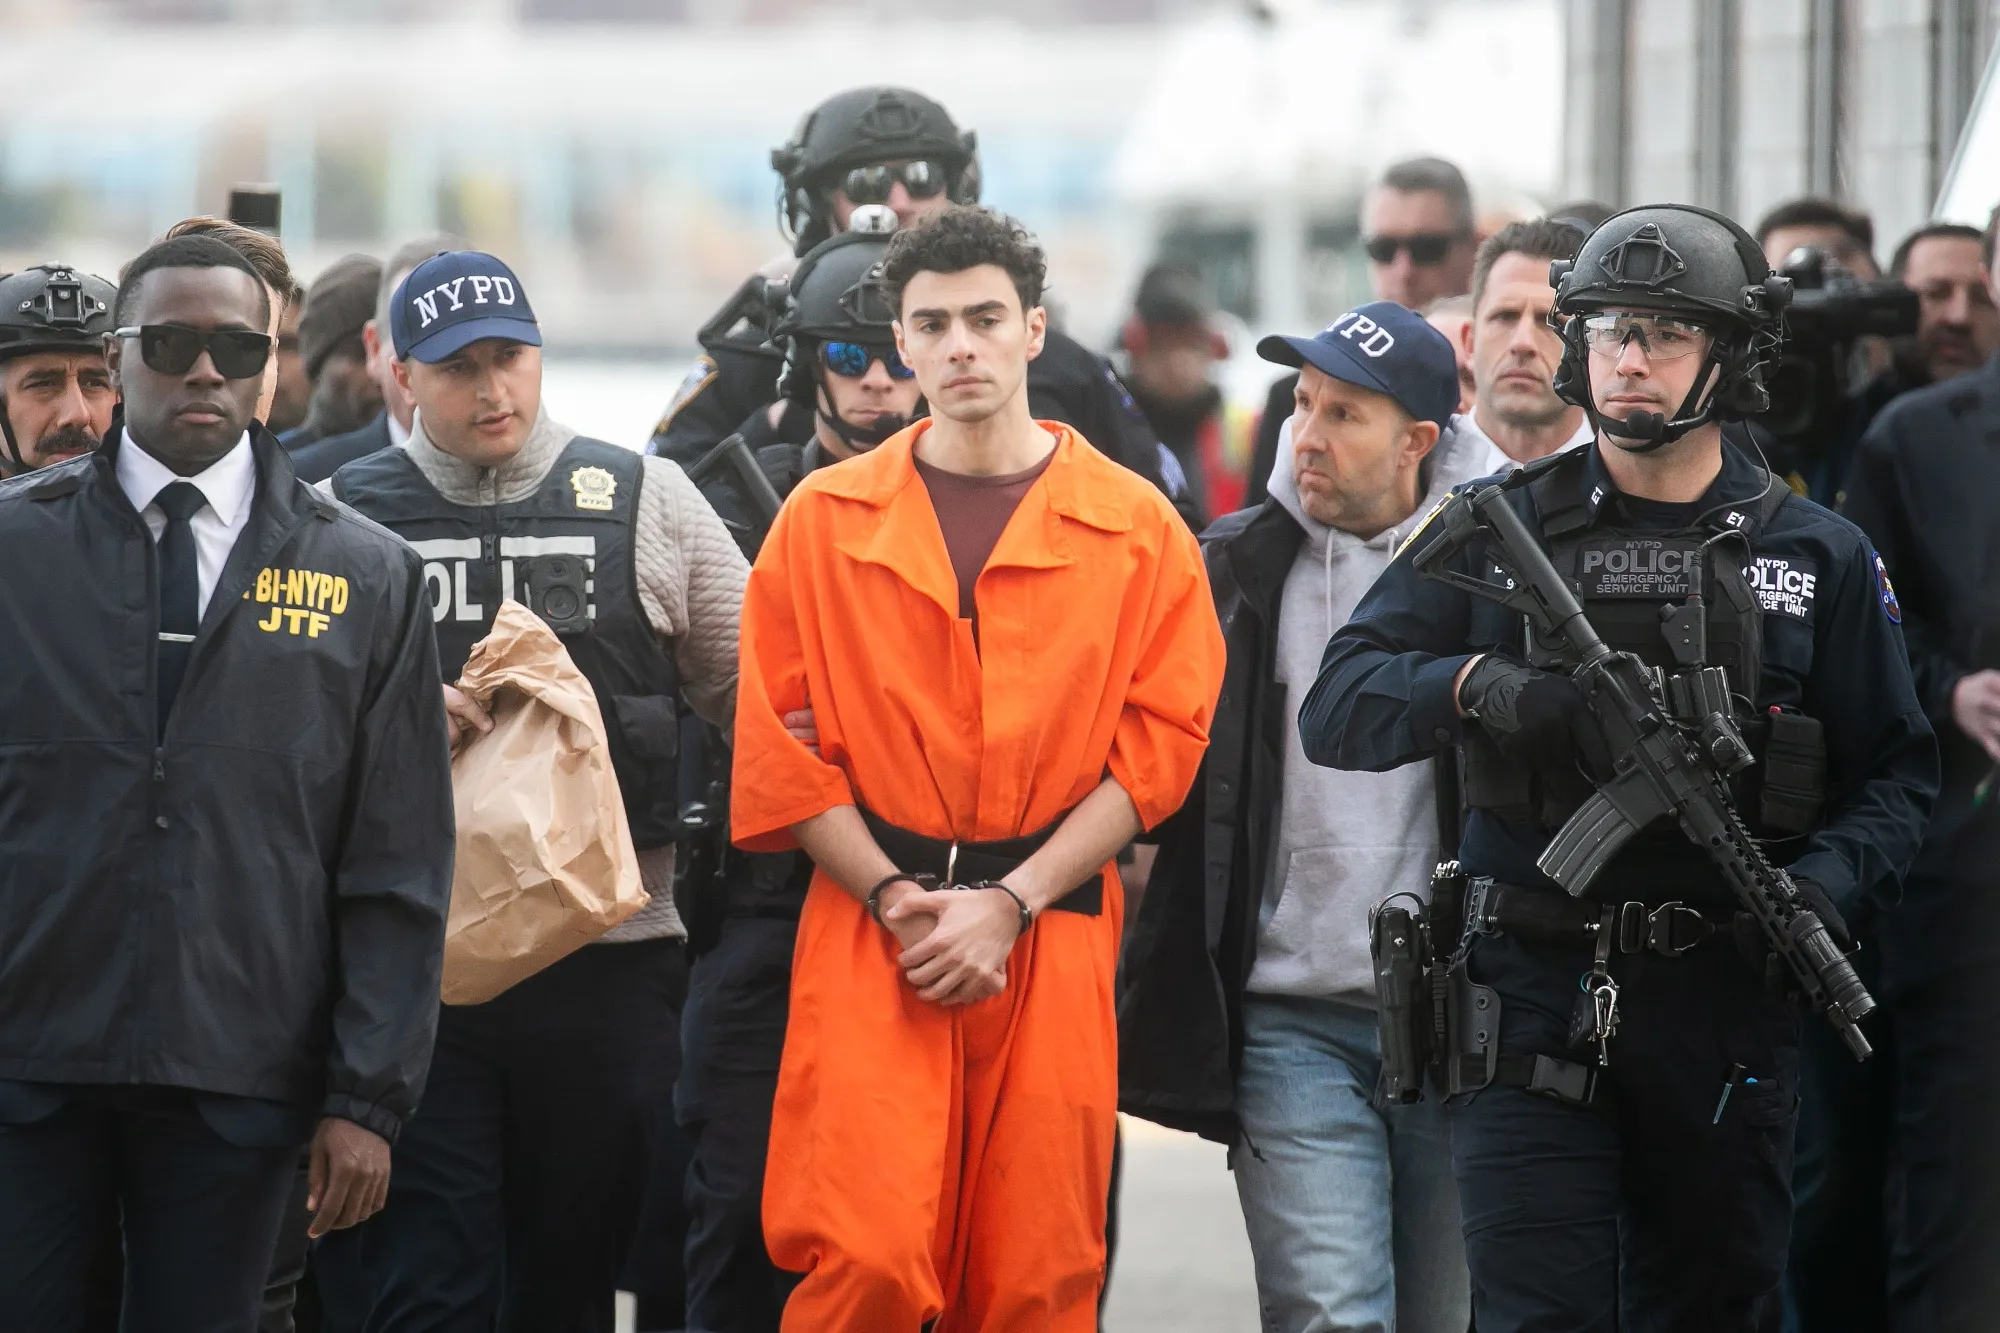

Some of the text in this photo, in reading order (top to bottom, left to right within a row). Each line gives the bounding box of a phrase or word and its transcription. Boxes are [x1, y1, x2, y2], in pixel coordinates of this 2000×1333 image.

[413, 275, 516, 329] NYPD
[1325, 312, 1395, 358] YPD
[1726, 511, 1746, 528] E1
[1625, 540, 1662, 549] NYPD
[1756, 557, 1789, 570] NYPD
[1602, 574, 1682, 584] EMERGENCY
[1741, 565, 1817, 600] OLICE
[242, 567, 349, 615] BI-NYPD
[1596, 584, 1689, 593] SERVICE UNIT
[1784, 602, 1808, 617] UNIT
[258, 606, 331, 639] JTF
